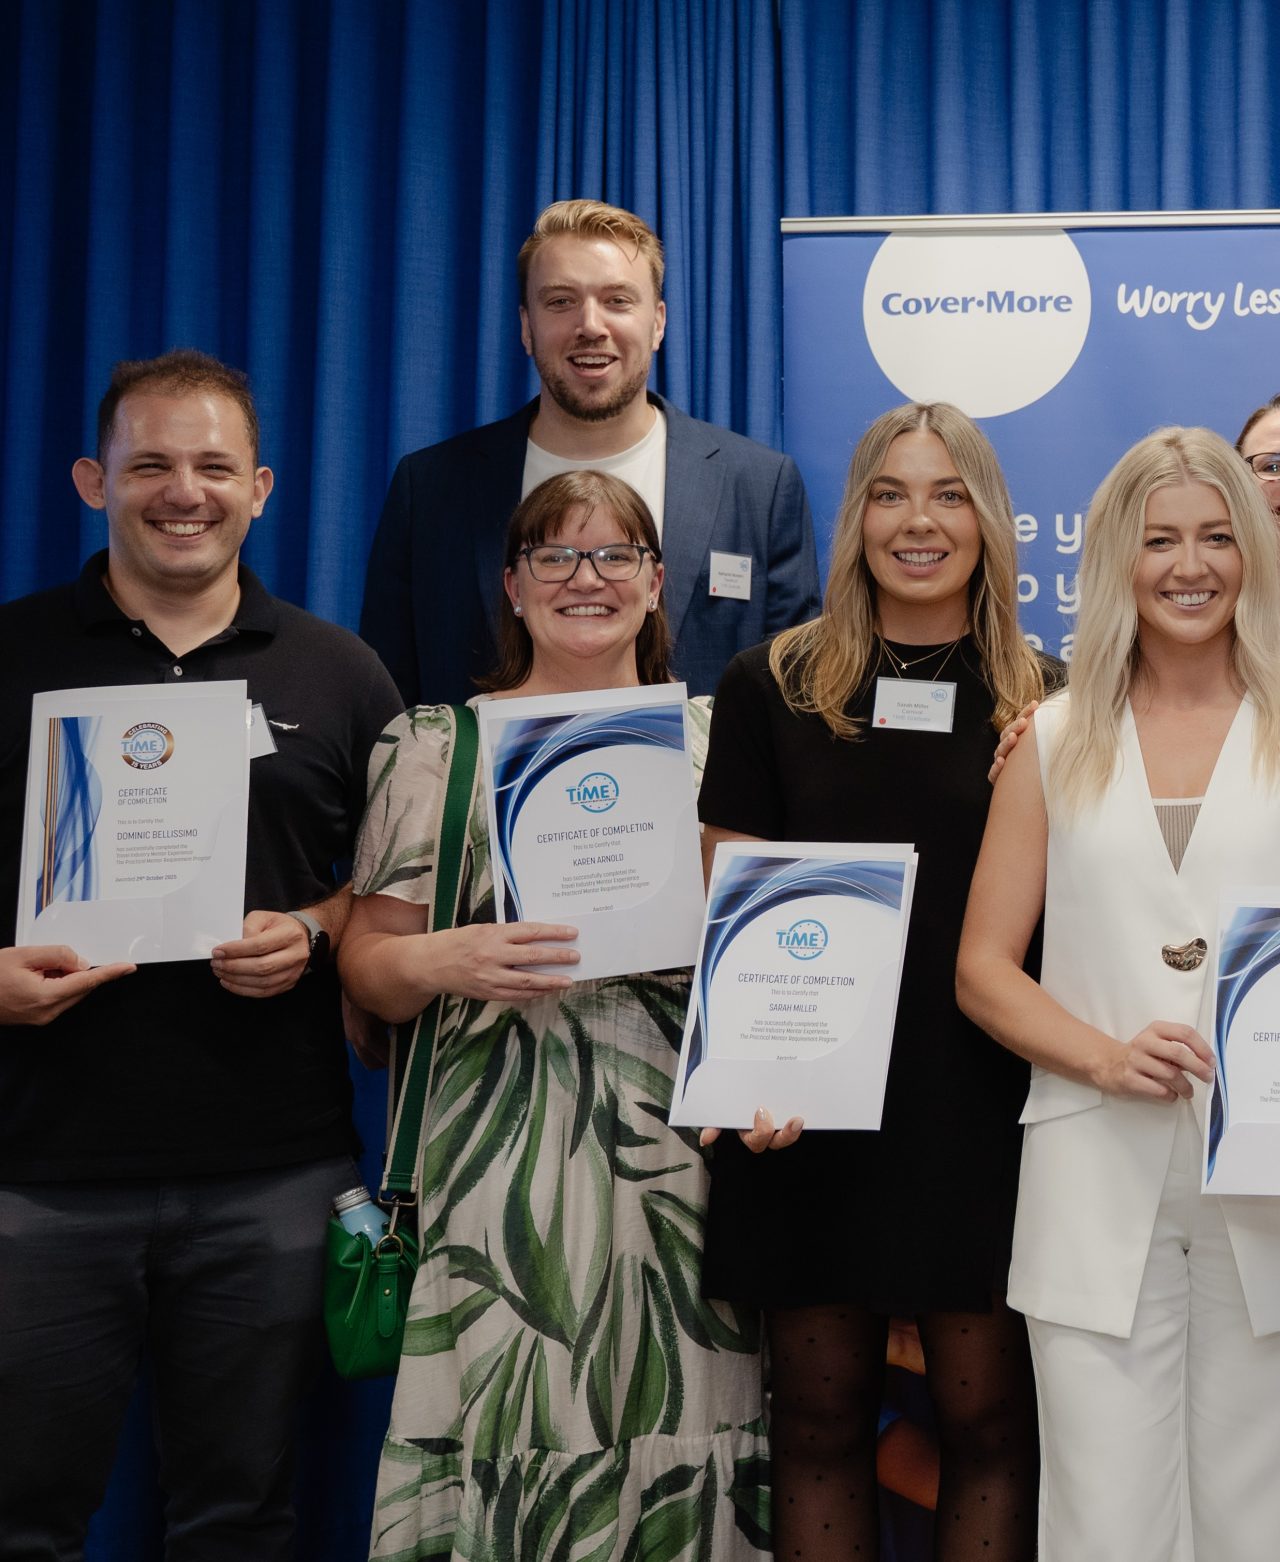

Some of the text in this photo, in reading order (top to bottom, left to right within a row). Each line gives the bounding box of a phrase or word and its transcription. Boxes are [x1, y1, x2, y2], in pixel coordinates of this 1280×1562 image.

[1117, 283, 1225, 331] Worry
[140, 760, 162, 769] YEARS
[119, 787, 167, 797] CERTIFICATE
[566, 785, 610, 802] TiME
[128, 797, 167, 805] COMPLETION
[117, 829, 198, 840] DOMINIC BELLISSIMO
[537, 822, 654, 843] CERTIFICATE OF COMPLETION
[573, 853, 624, 866] KAREN ARNOLD
[776, 931, 819, 947] TiME
[738, 973, 855, 986] CERTIFICATE OF COMPLETION
[769, 1003, 817, 1012] SARAH MILLER
